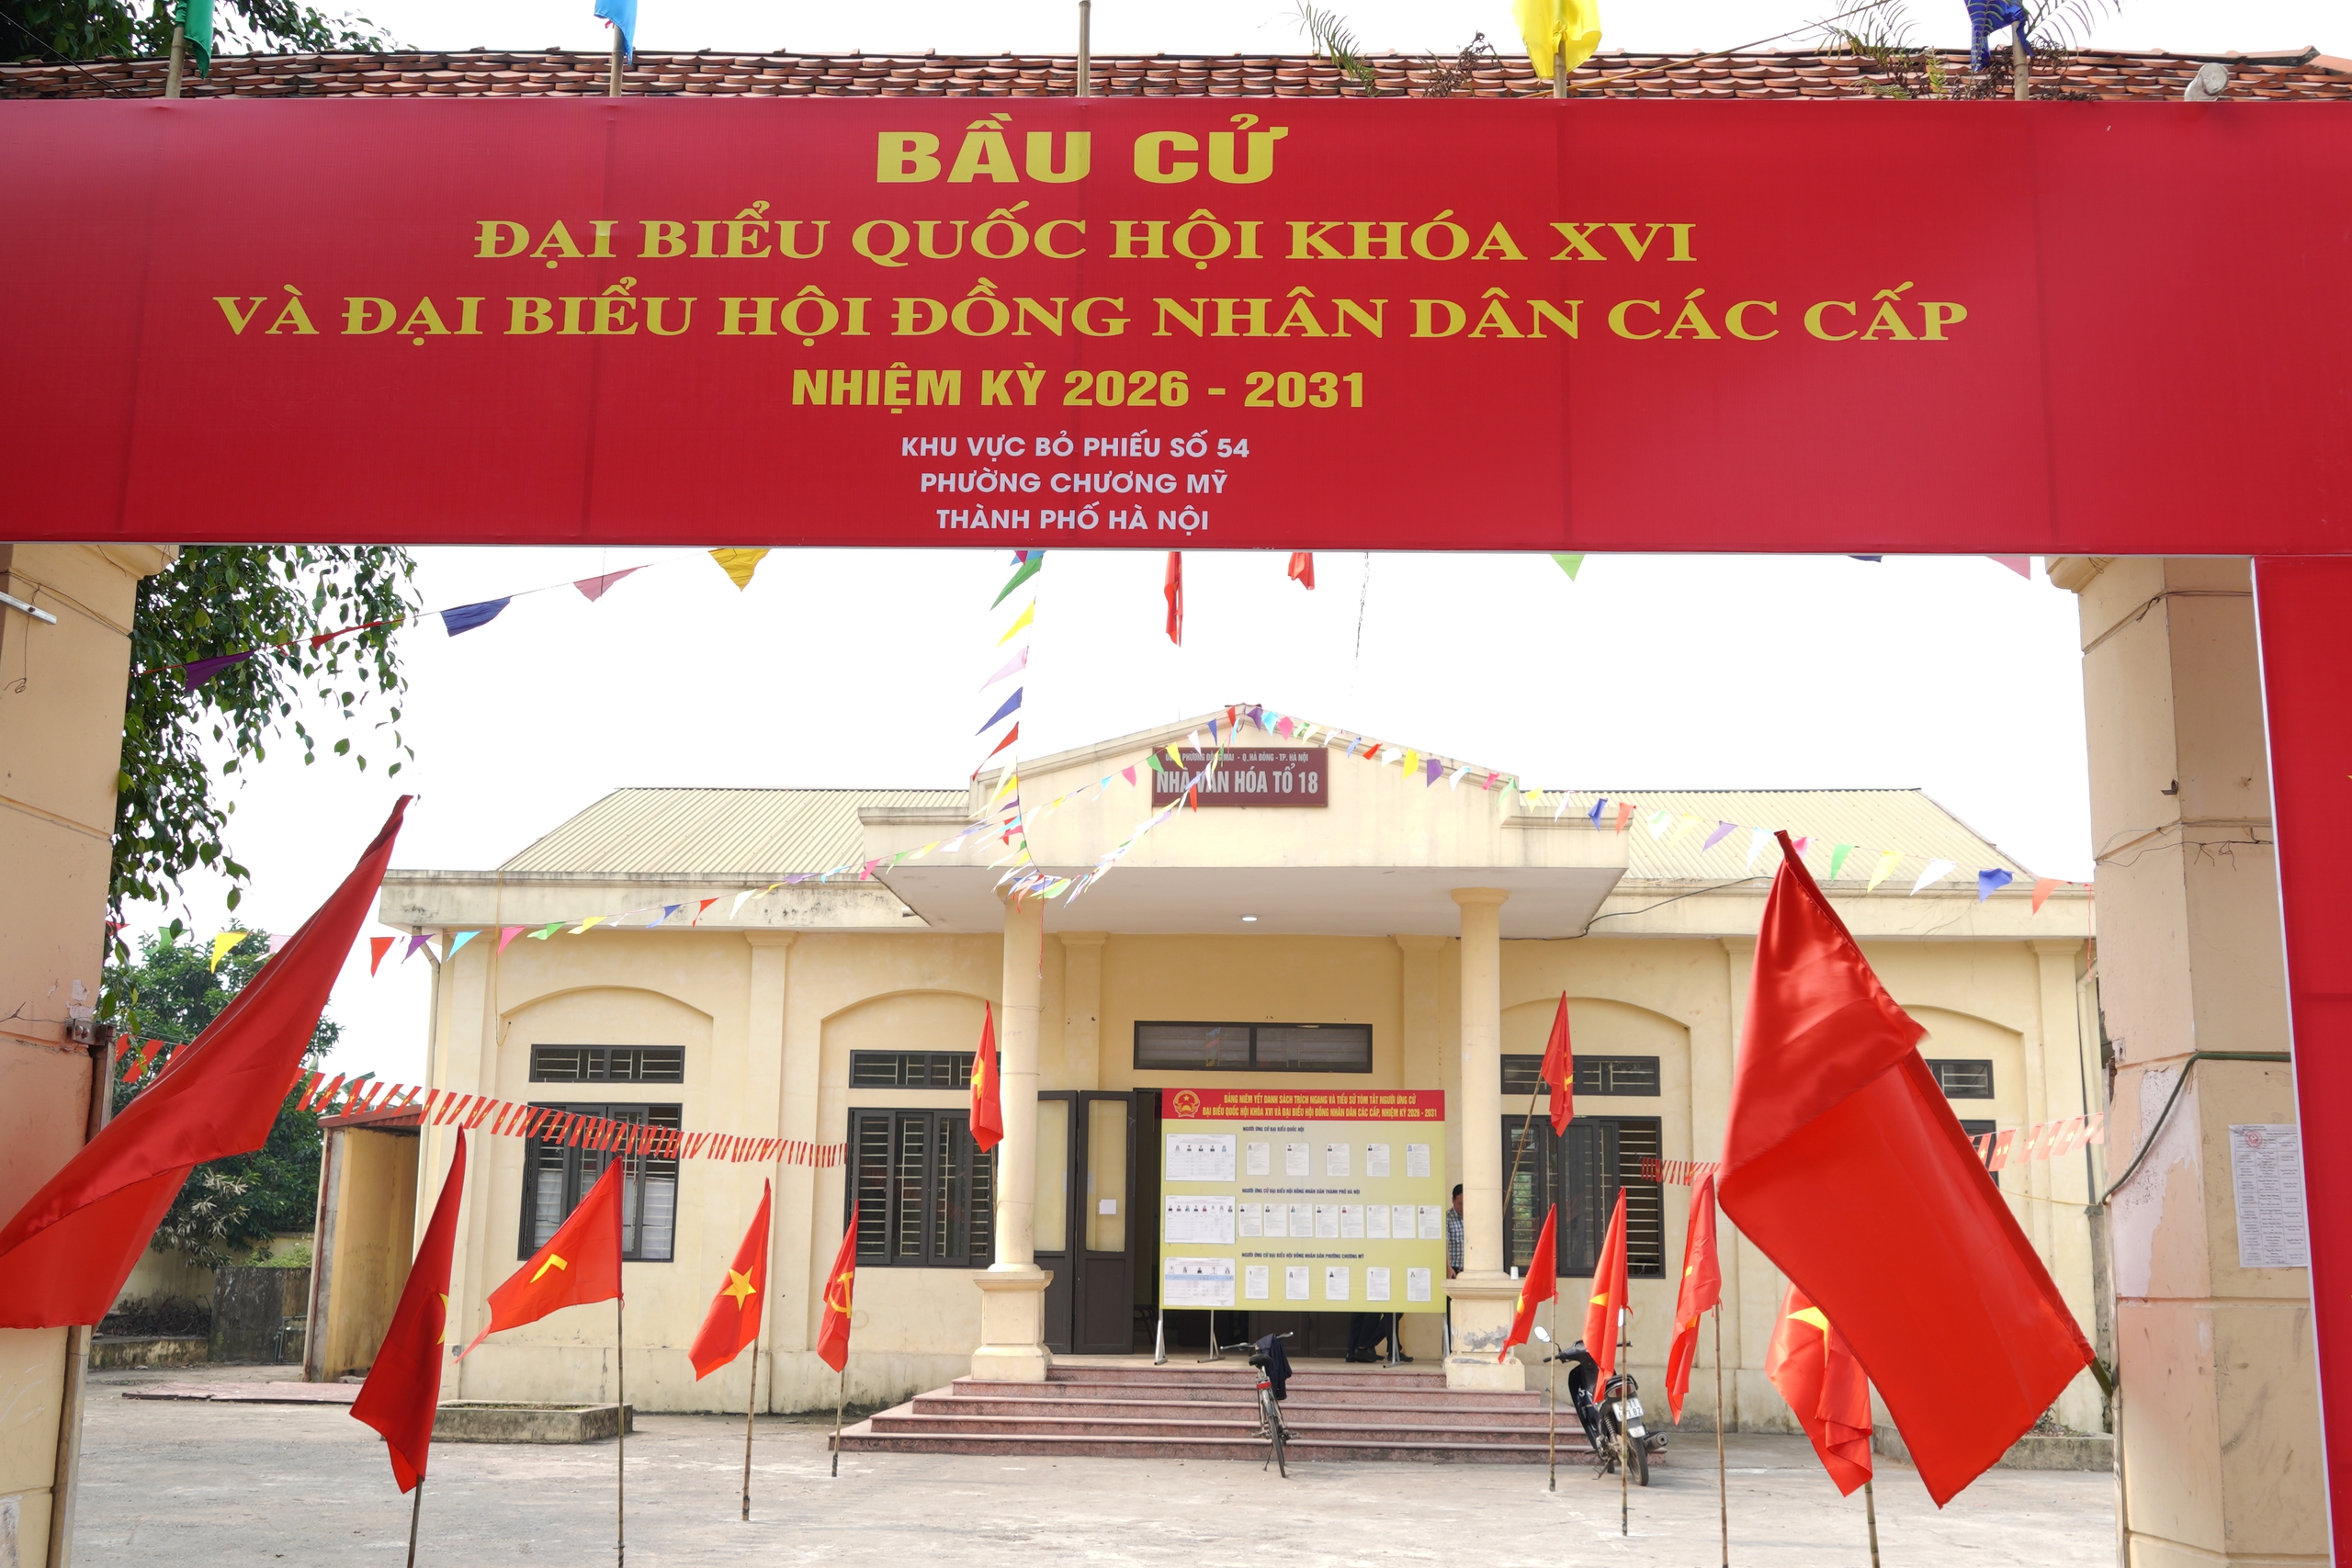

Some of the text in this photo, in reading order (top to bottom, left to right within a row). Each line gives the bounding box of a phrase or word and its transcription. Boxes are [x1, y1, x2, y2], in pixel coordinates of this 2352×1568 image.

[876, 113, 1288, 185] BẦU CỬ
[474, 200, 1697, 269] ĐẠI BIỂU QUỐC HỘI KHÓA XVI
[213, 276, 1967, 346] VÀ ĐẠI BIỂU HỘI ĐỒNG NHÂN DÂN CÁC CẤP
[793, 362, 1363, 414] NHIỆM KỲ 2026 - 2031
[902, 429, 1249, 463] KHU VỰC BỎ PHIẾU SỐ 54
[922, 467, 1227, 494] PHƯỜNG CHƯƠNG MỸ
[937, 501, 1207, 536] THÀNH PHỐ HÀ NỘI
[1289, 751, 1297, 761] HÀ
[1298, 751, 1309, 763] NỘI
[1234, 765, 1268, 794] HÓA
[1272, 762, 1295, 794] TỔ
[1298, 771, 1318, 794] 18
